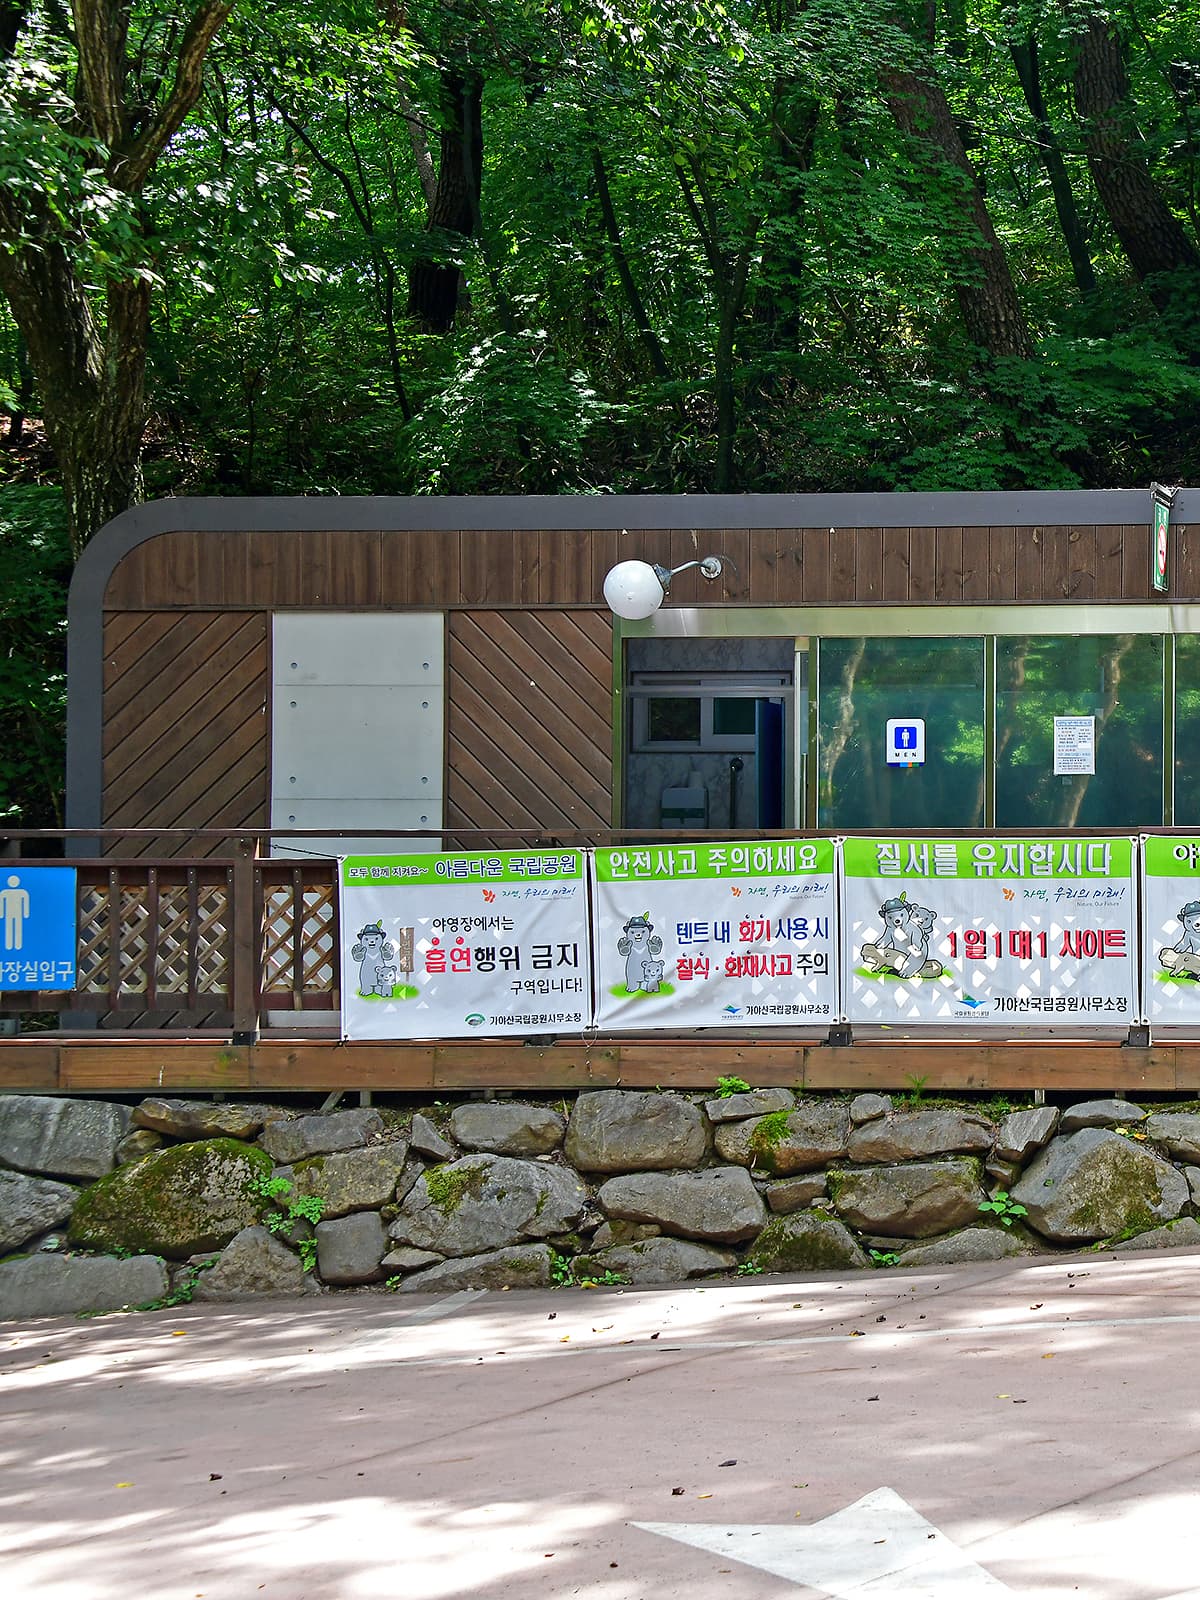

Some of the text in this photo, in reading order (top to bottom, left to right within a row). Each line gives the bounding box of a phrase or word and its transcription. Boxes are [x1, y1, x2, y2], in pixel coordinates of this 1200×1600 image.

[349, 867, 369, 878] 모두
[371, 867, 390, 878] 함께
[434, 859, 504, 878] 아름다운
[508, 855, 577, 876] 국립공원
[609, 845, 818, 878] 안전사고 주의하세요
[876, 842, 1113, 877] 질서를 유지합시다
[1054, 886, 1091, 903] 우리의
[1092, 886, 1126, 900] 미래!
[432, 916, 515, 933] 야영장에서는
[676, 916, 829, 944] 텐트 내 화기 사용 시
[1058, 929, 1128, 959] 사이트
[424, 944, 521, 974] 흡연행위
[531, 943, 579, 970] 금지
[724, 954, 792, 978] 화재사고
[797, 952, 829, 976] 주의
[510, 977, 583, 996] 구역입니다!
[993, 997, 1128, 1013] 가야산국립공원사무소장
